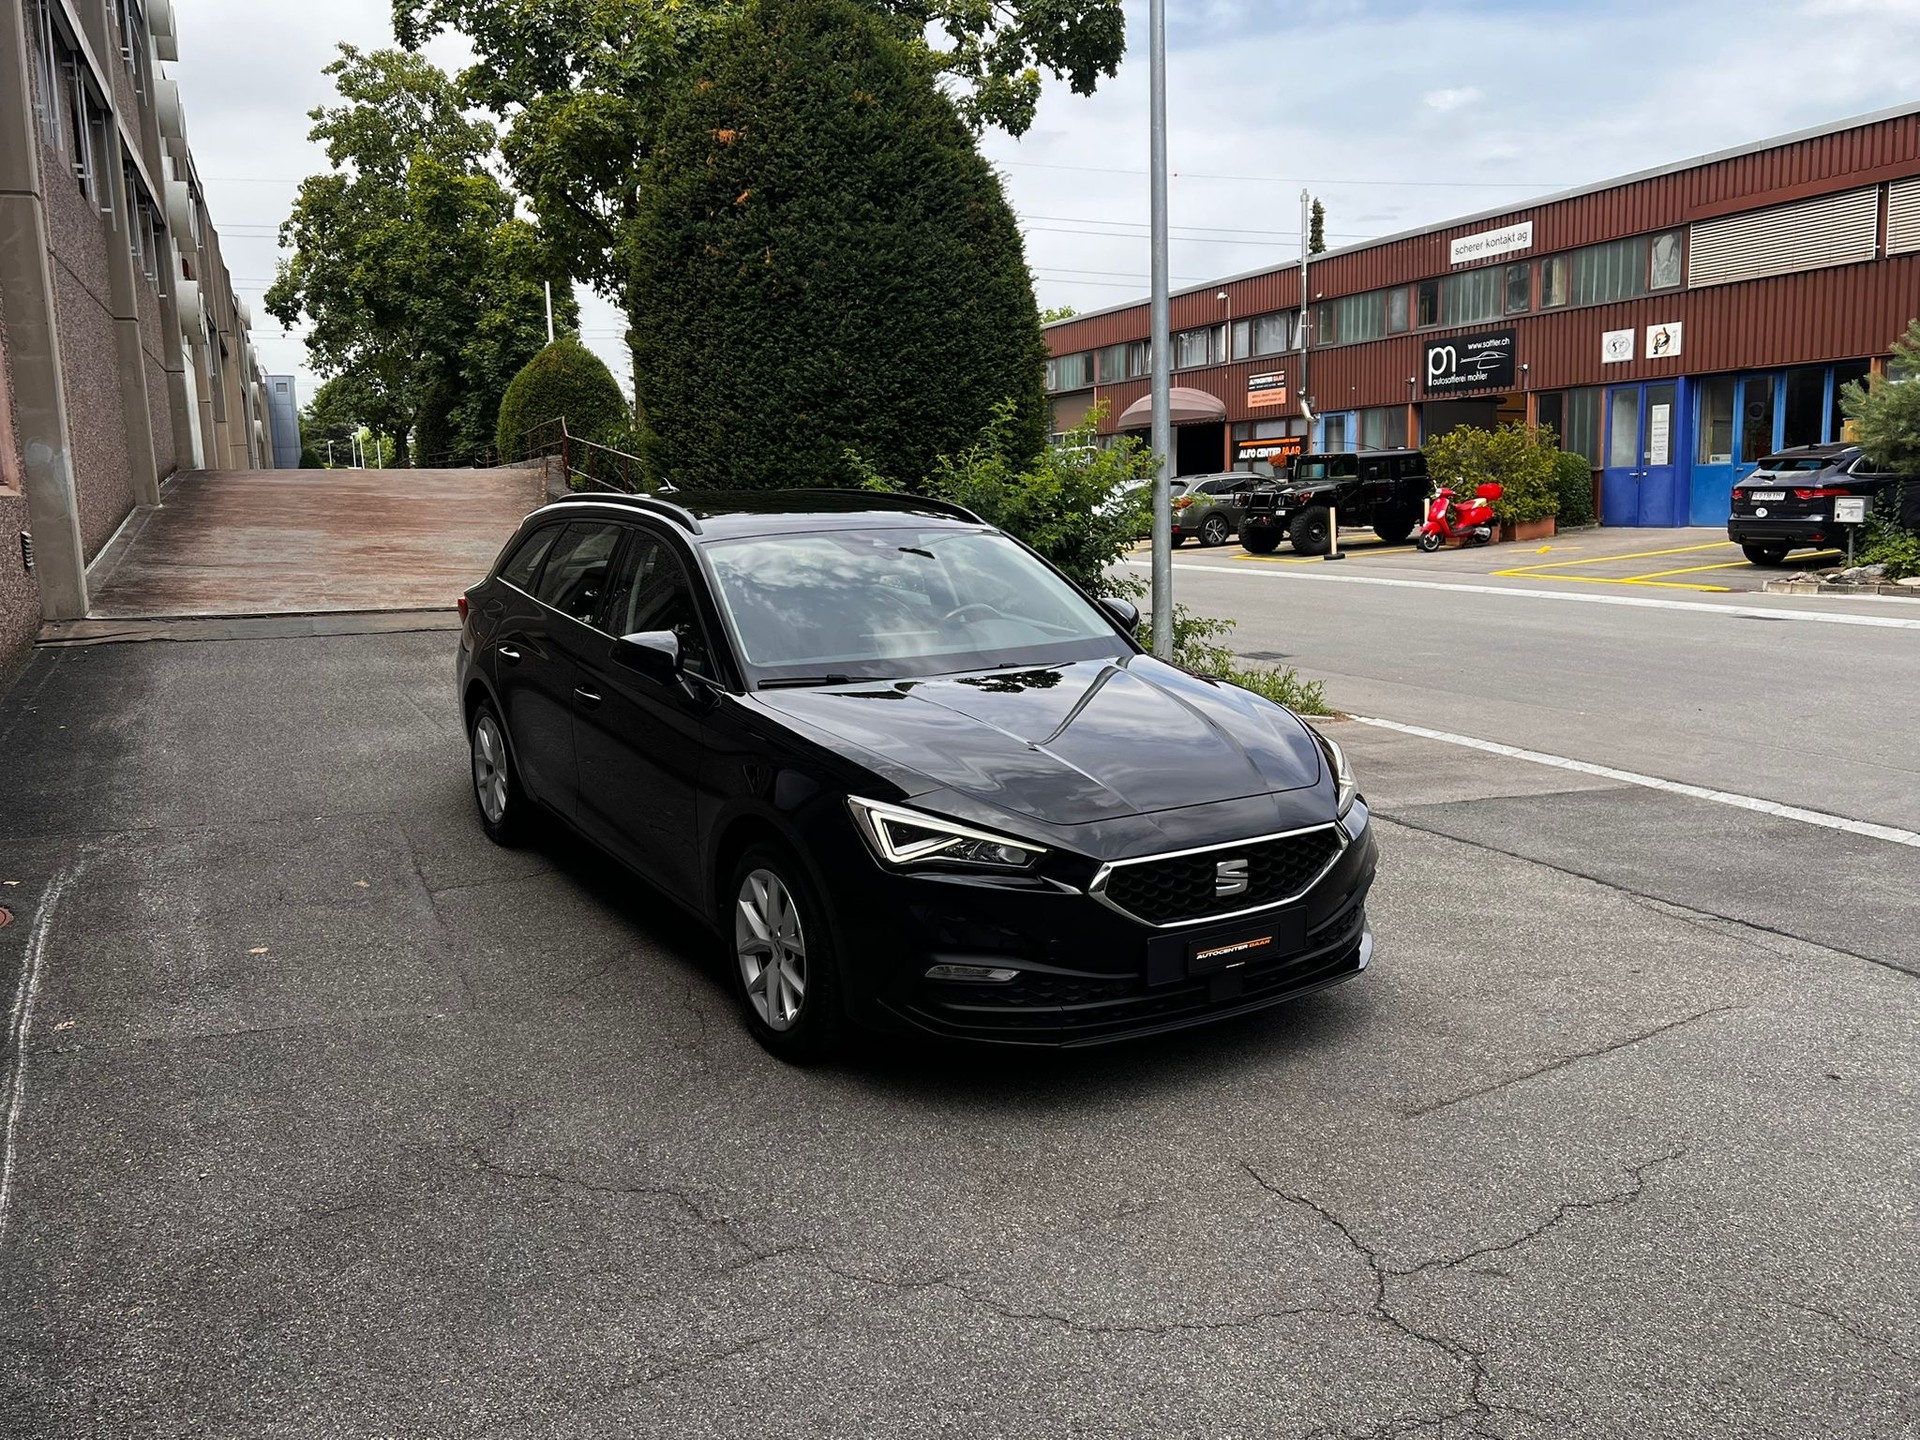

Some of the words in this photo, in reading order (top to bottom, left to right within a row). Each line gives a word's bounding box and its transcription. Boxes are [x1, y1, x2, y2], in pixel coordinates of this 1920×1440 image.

[1455, 241, 1483, 256] scherer
[1485, 233, 1516, 248] kontakt
[1517, 231, 1528, 242] ag
[1238, 448, 1256, 460] AUTO
[1196, 944, 1249, 960] AUTOCENTER
[1249, 939, 1271, 948] BAAR
